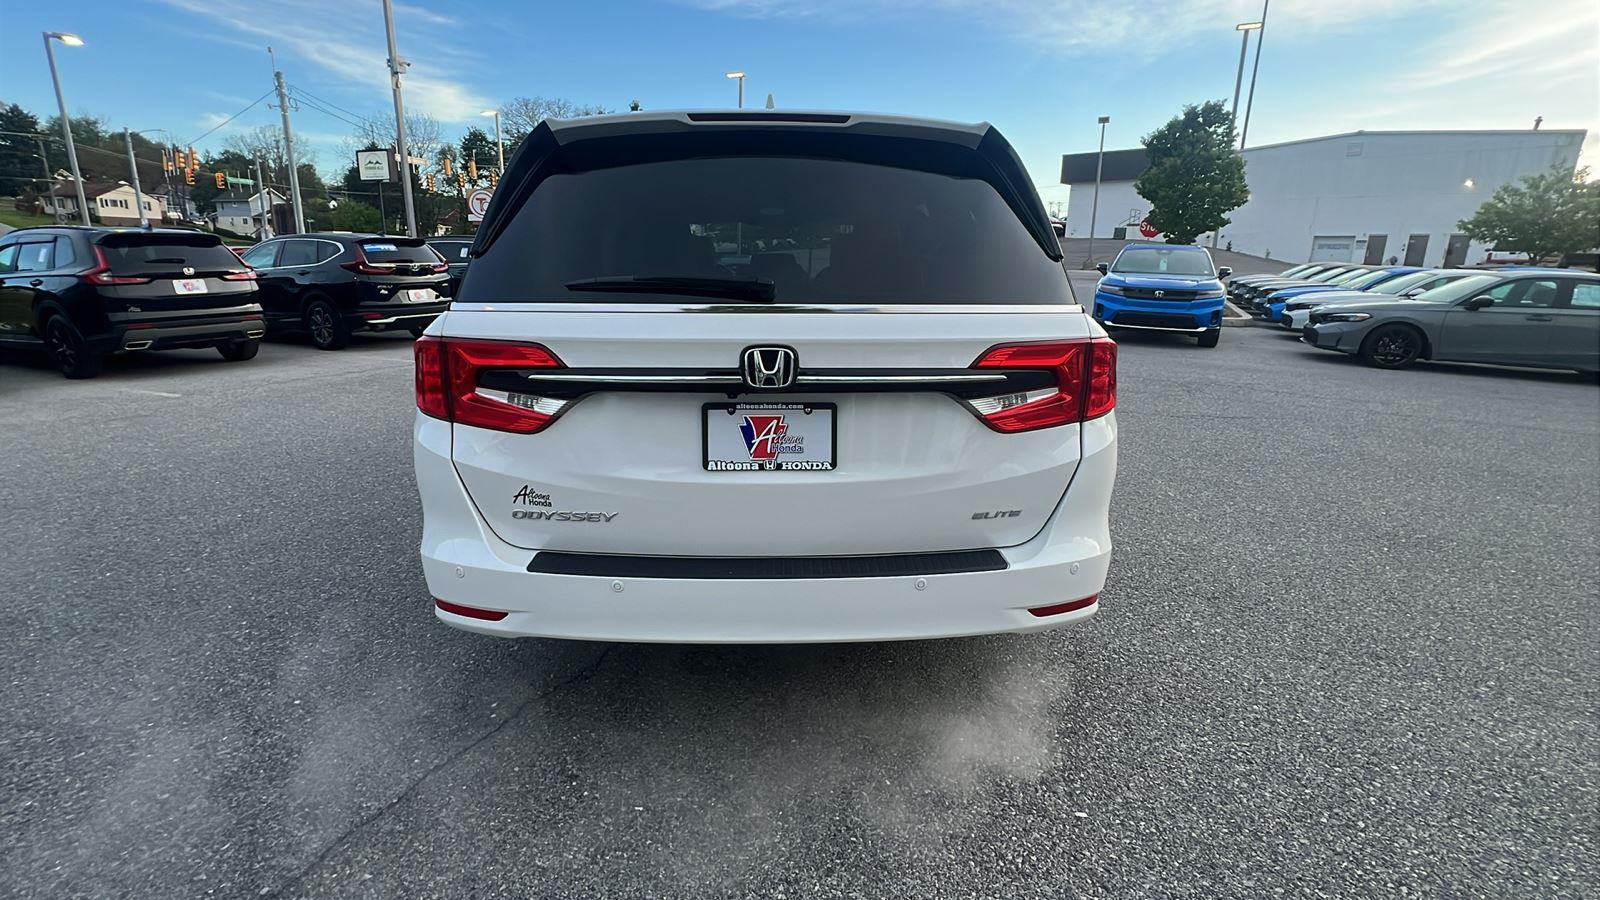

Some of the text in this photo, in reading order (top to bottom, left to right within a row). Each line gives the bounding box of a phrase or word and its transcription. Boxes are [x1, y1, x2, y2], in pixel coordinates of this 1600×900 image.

[750, 419, 804, 453] Altoona
[771, 442, 803, 453] Honda
[707, 461, 759, 471] Altoona
[781, 462, 832, 470] HONDA
[512, 485, 550, 505] Altoona
[529, 499, 552, 507] Honda
[512, 509, 618, 522] ODYSSEY
[972, 510, 1021, 520] ELITE
